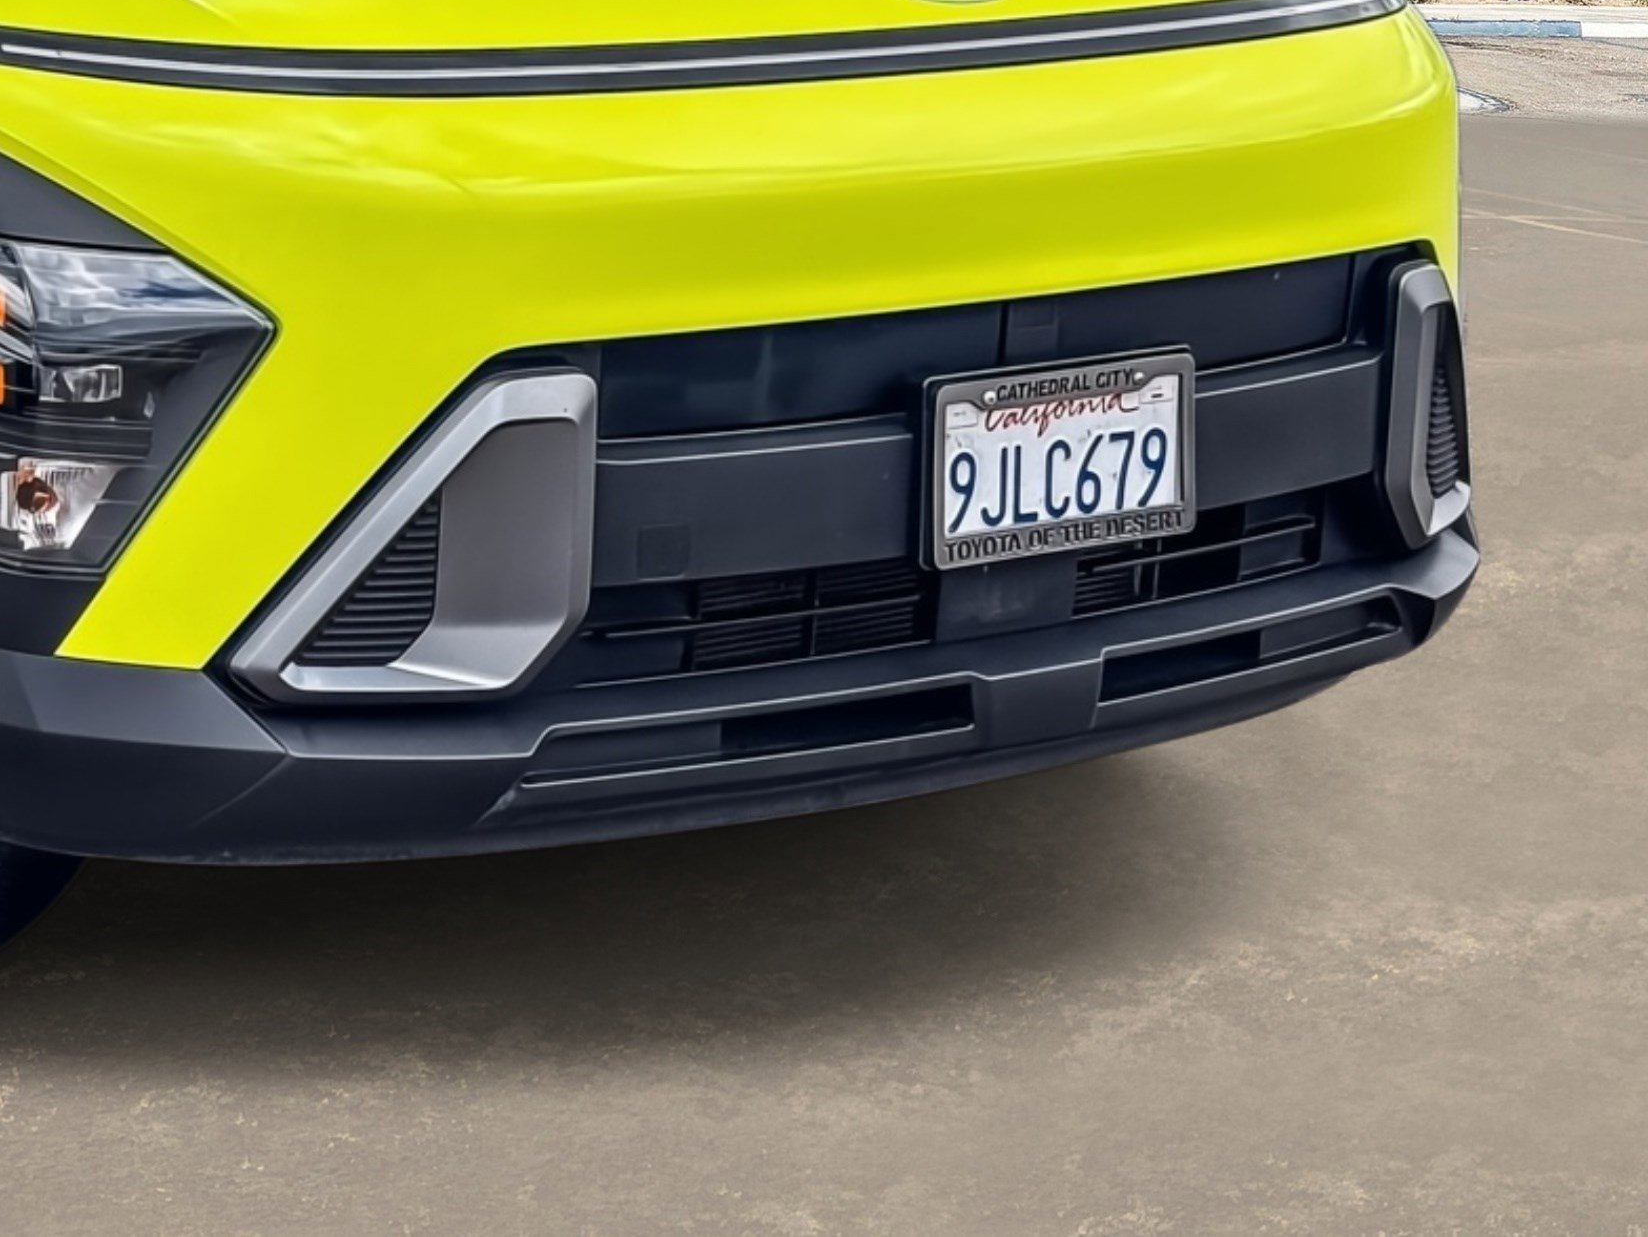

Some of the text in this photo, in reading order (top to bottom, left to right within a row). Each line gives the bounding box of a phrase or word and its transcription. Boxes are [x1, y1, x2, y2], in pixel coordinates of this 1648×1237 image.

[996, 368, 1135, 403] CATHEDRAL CITY
[984, 393, 1140, 438] California
[948, 427, 1168, 534] 9JLC679
[945, 512, 1184, 562] TOYOTA OF THE DESERT
